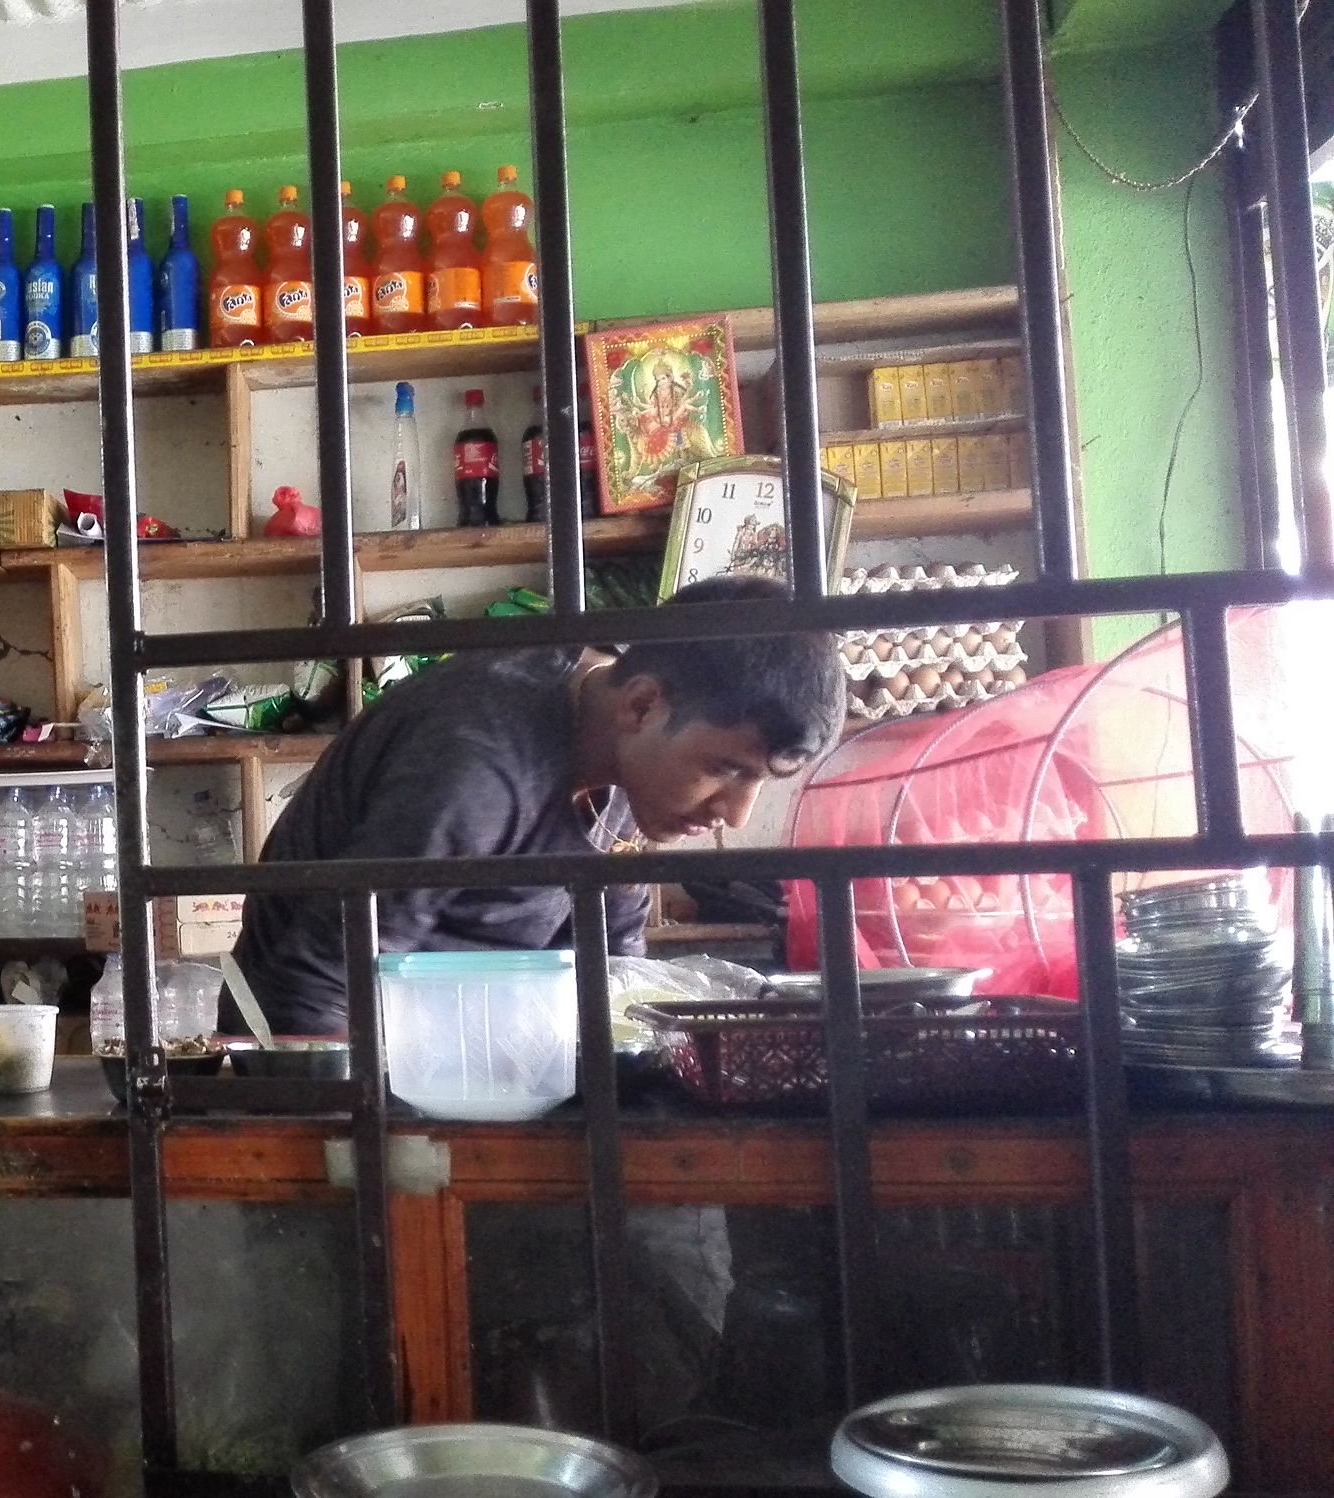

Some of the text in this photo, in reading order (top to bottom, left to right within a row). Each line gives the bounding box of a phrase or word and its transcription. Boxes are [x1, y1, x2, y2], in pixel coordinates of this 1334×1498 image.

[223, 292, 252, 312] Fanta
[279, 289, 308, 309] Fanta
[721, 483, 736, 499] 11
[756, 482, 775, 499] 12
[696, 507, 713, 524] 10
[693, 538, 705, 554] 9
[688, 568, 699, 584] 8
